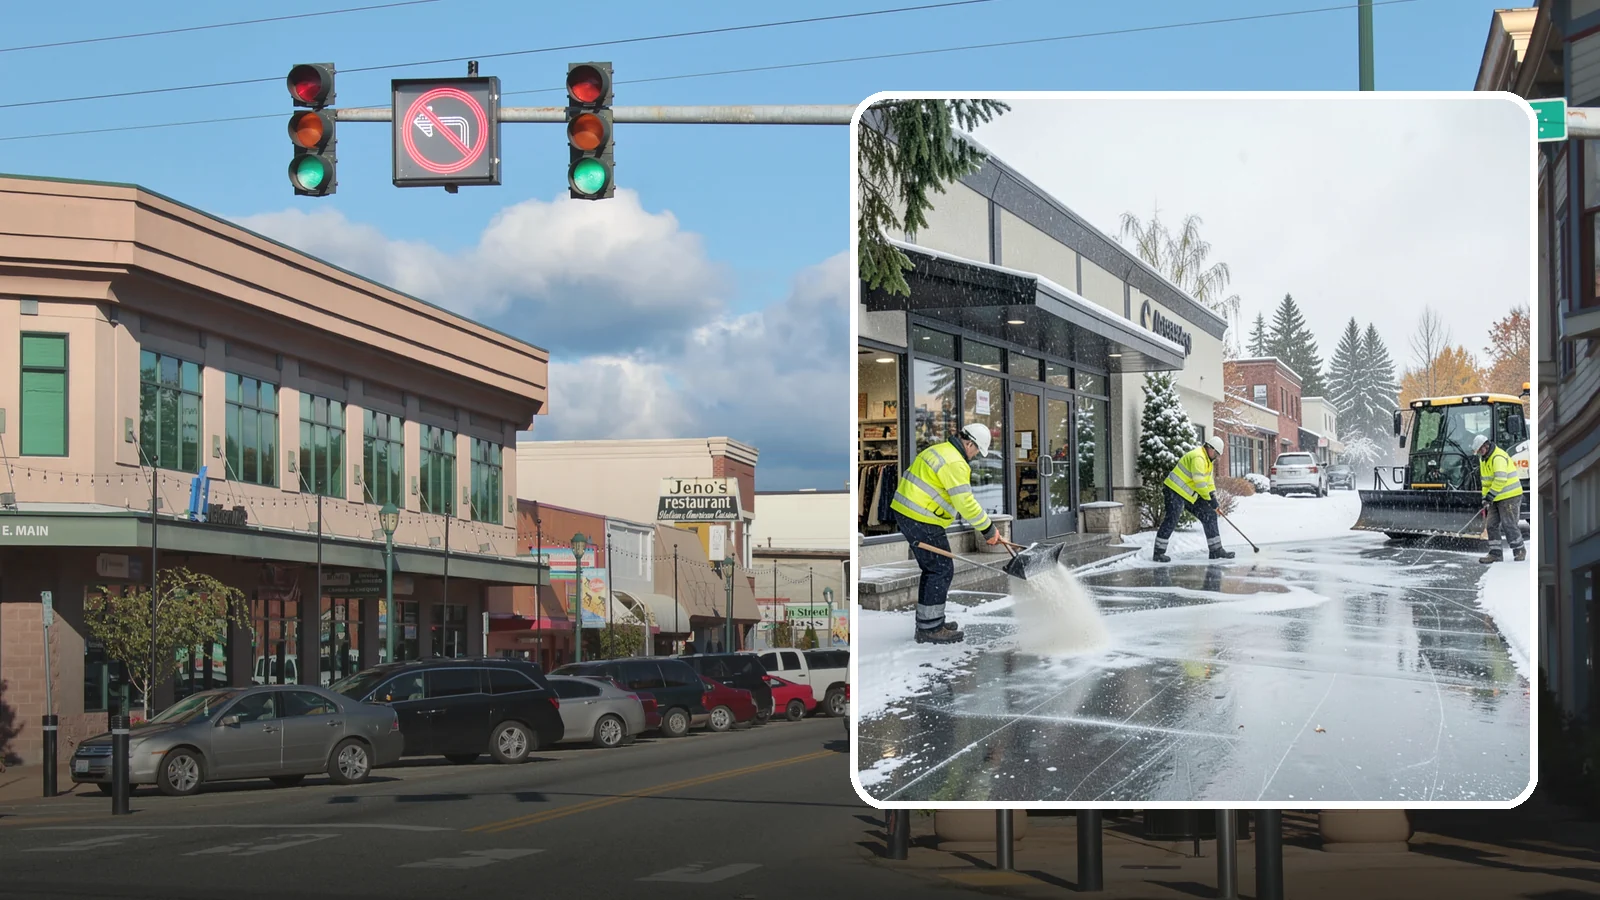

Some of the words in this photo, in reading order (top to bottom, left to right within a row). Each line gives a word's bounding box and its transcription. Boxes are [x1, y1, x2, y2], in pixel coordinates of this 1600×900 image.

[669, 480, 728, 495] Jeno's
[665, 496, 731, 509] restaurant
[658, 510, 681, 519] Italian
[686, 510, 714, 519] American
[715, 509, 737, 519] Cuisine
[2, 525, 13, 536] E.
[15, 525, 49, 536] MAIN
[797, 607, 828, 617] Street
